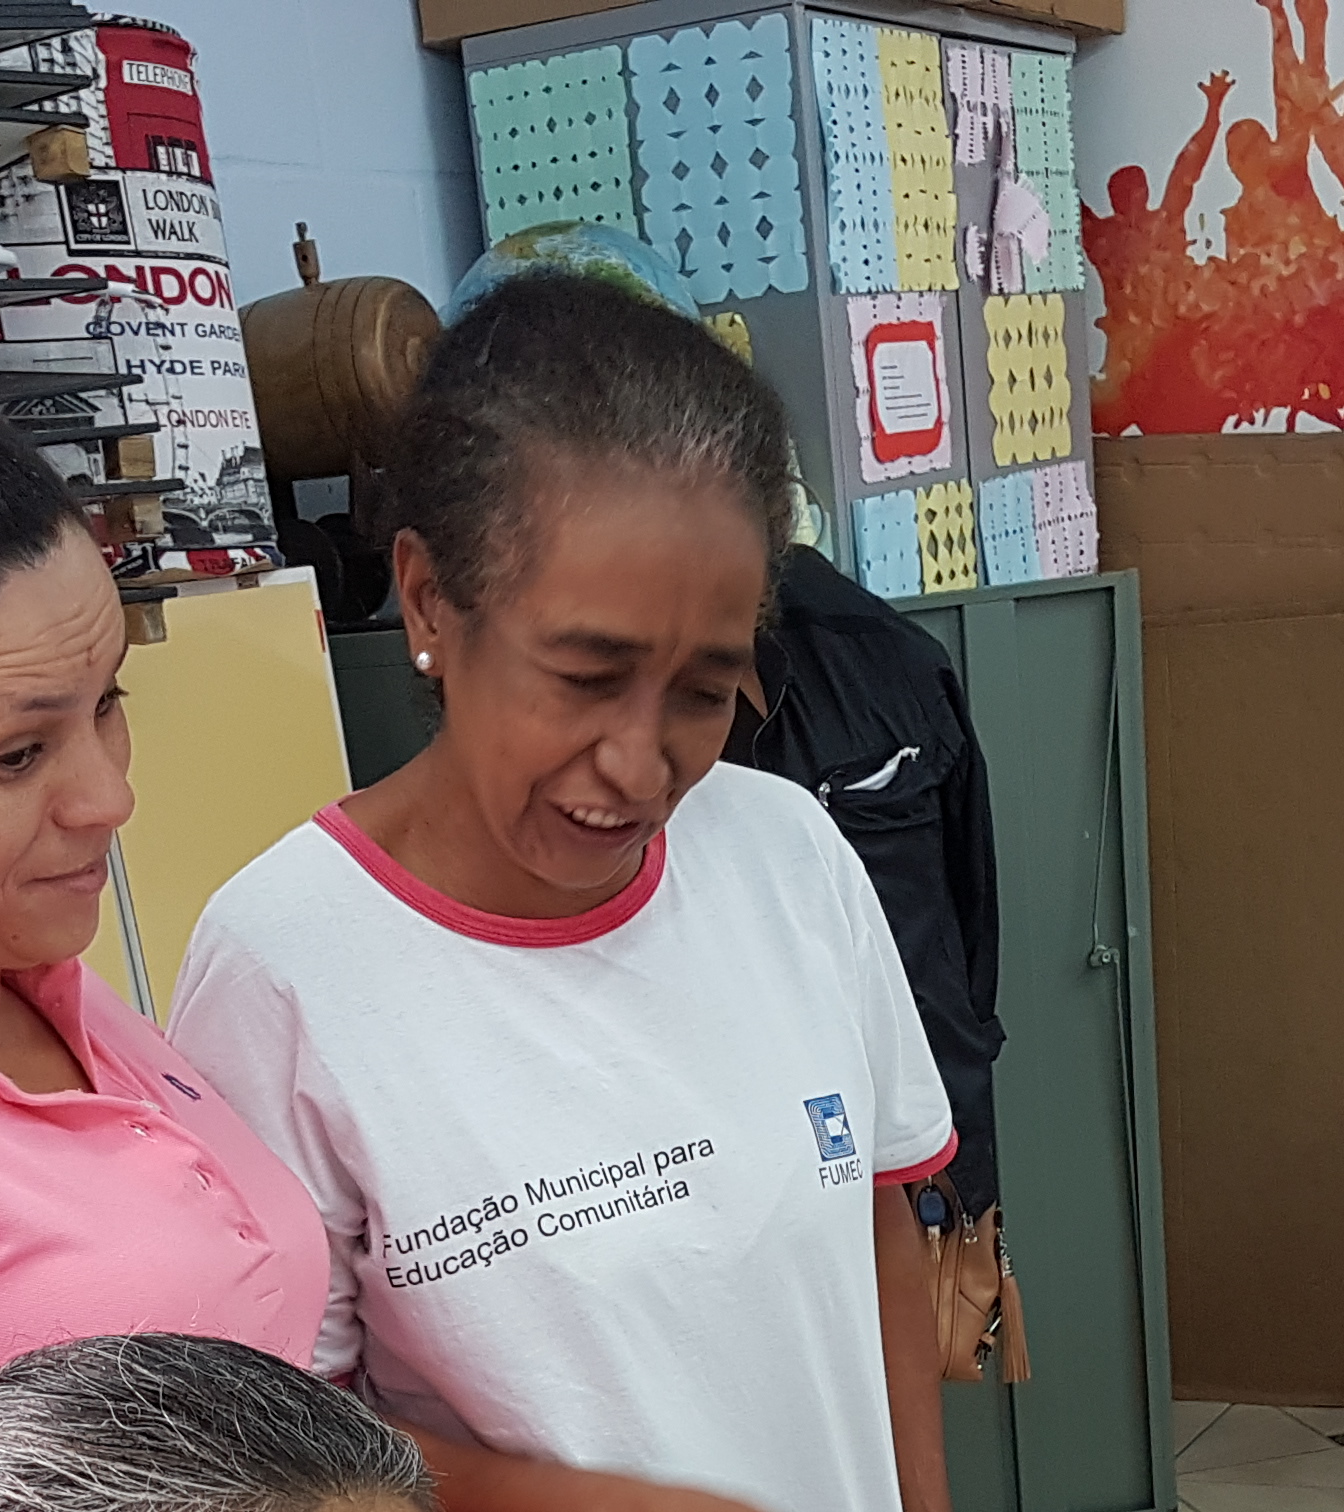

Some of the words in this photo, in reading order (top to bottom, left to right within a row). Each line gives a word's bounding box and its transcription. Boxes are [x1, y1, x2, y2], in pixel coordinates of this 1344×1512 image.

[126, 62, 189, 92] TELEPHONE
[142, 188, 210, 217] LONDON
[147, 218, 199, 243] WALK
[6, 263, 234, 311] ONDON
[85, 321, 188, 338] COVENT
[125, 359, 205, 376] HYDE
[211, 360, 247, 379] PARK
[155, 409, 229, 429] LONDON
[232, 411, 252, 429] EYE
[818, 1158, 864, 1189] FUMEC
[382, 1194, 519, 1259] Fundação
[524, 1152, 646, 1206] Municipal
[653, 1138, 715, 1177] para
[385, 1229, 529, 1288] Educação
[537, 1179, 691, 1237] Comunitária
